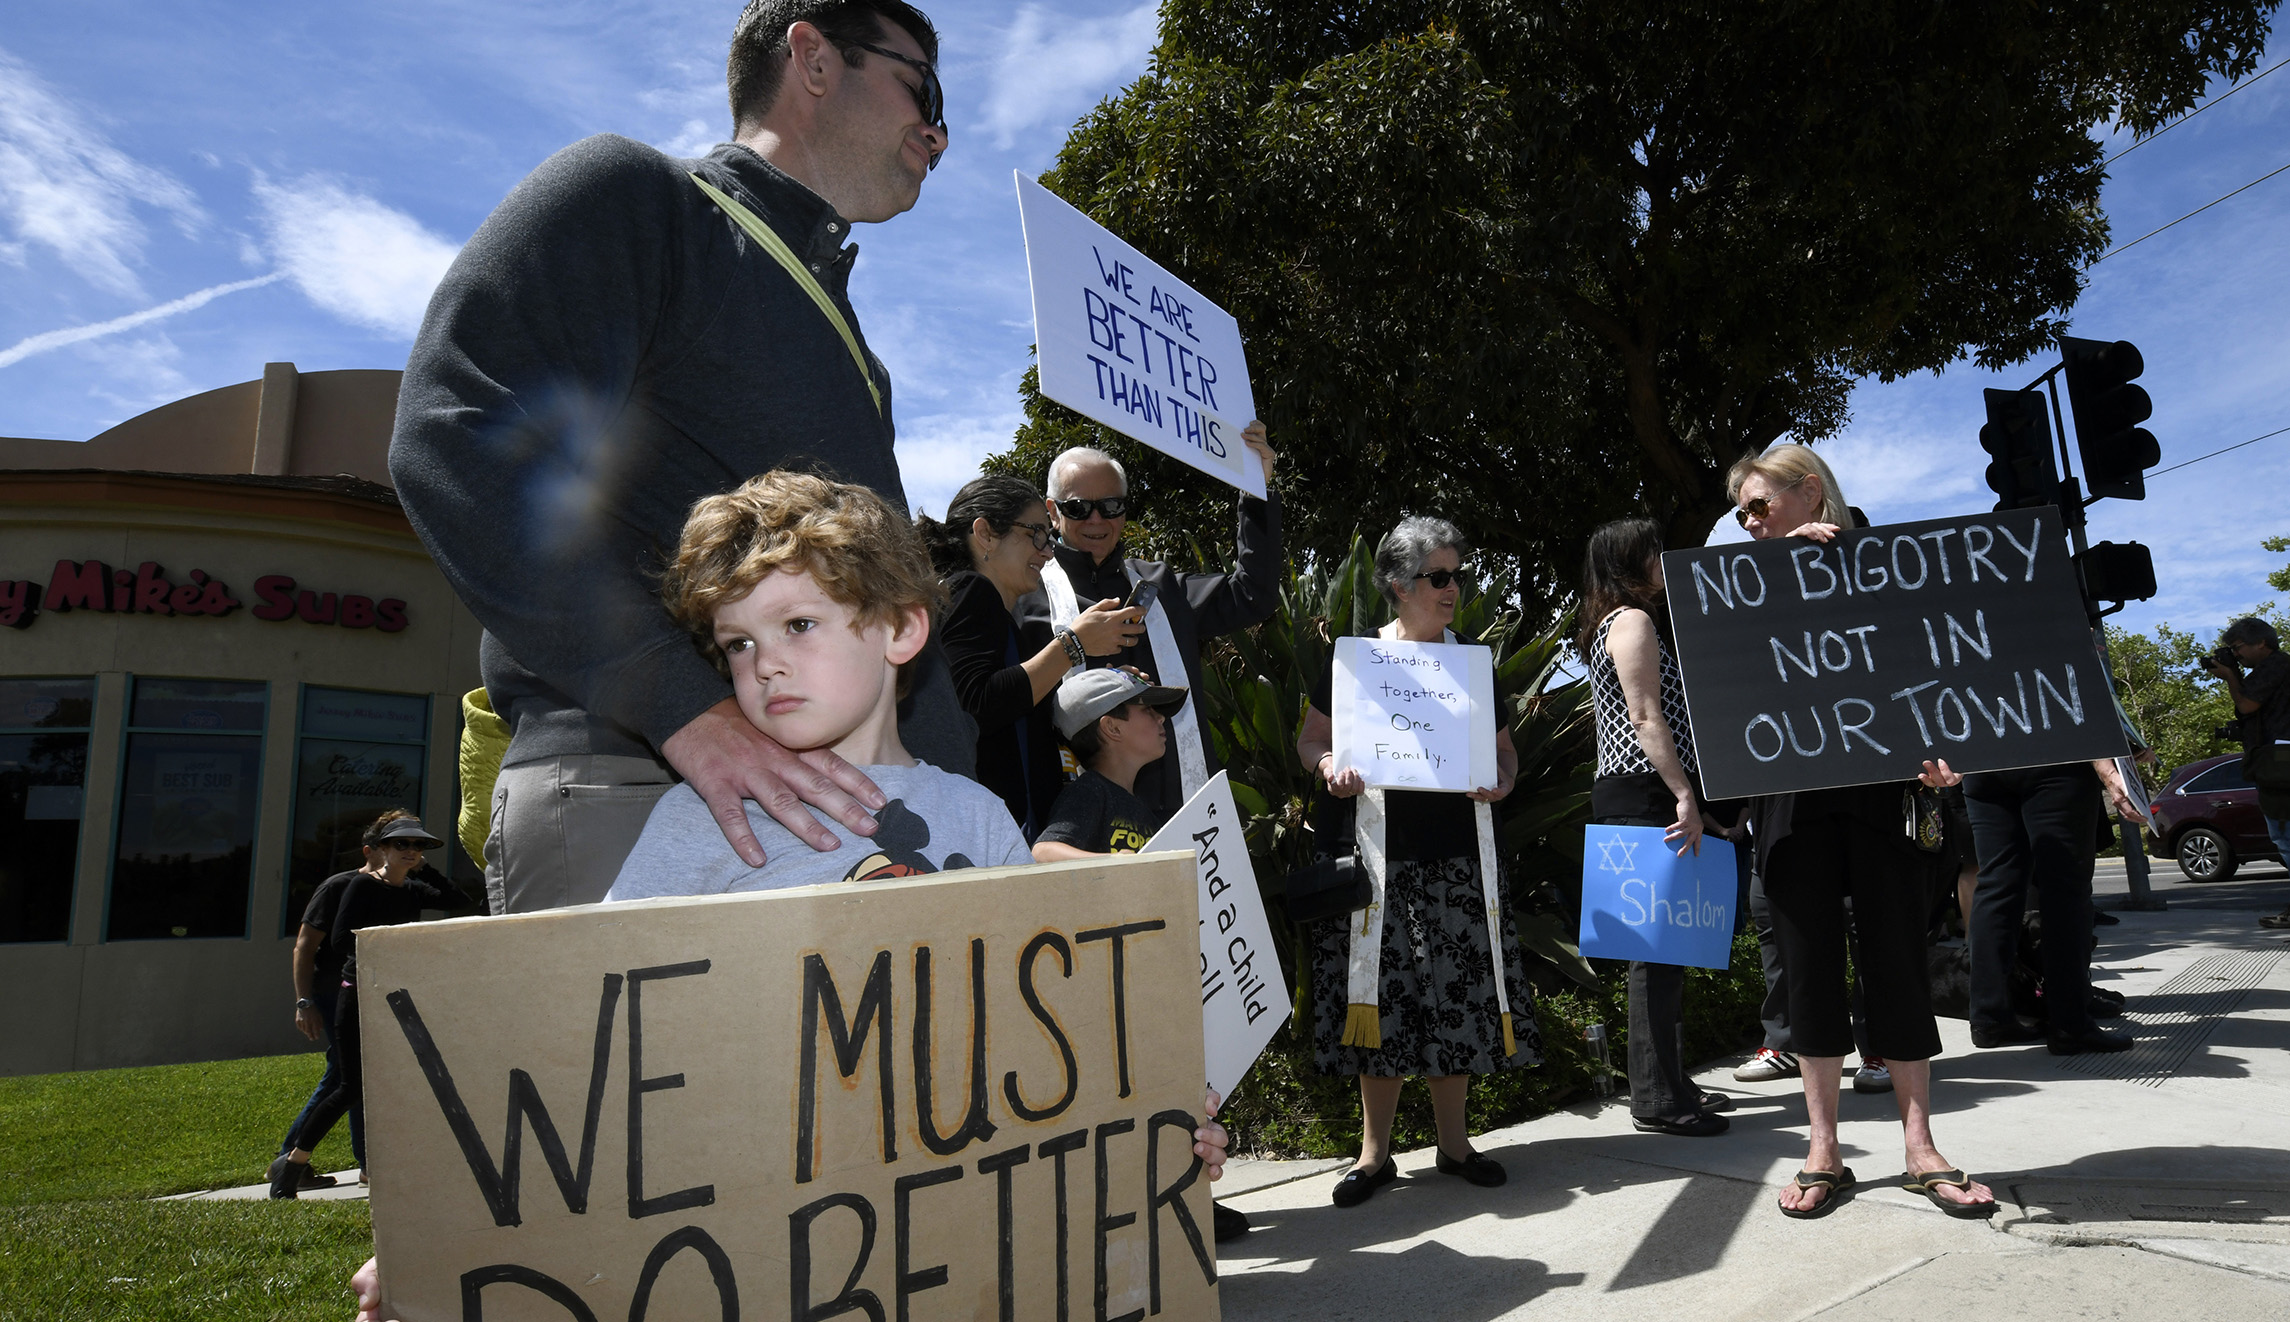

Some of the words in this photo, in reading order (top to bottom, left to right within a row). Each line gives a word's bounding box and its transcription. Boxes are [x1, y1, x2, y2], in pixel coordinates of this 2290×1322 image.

[1093, 246, 1141, 306] WE
[1150, 285, 1200, 343] ARE
[1084, 287, 1219, 411] BETTER
[1087, 353, 1163, 429] THAN
[1167, 396, 1227, 459] THIS
[43, 559, 241, 617] Mike's
[1691, 553, 1767, 615] NO
[1789, 517, 2042, 601] BIGOTRY
[1370, 648, 1441, 671] Standing
[1769, 624, 1878, 683] NOT
[1922, 608, 1992, 668] IN
[1379, 681, 1457, 703] together,
[1744, 697, 1891, 763] OUR
[1890, 663, 2085, 748] TOWN
[1391, 713, 1435, 732] One
[162, 772, 199, 787] BEST
[203, 772, 233, 787] SUB
[327, 754, 403, 784] Catering
[1375, 743, 1447, 769] Family.
[310, 777, 410, 798] Available!
[1110, 829, 1151, 850] FOR
[1620, 878, 1725, 931] Shalom
[1217, 903, 1237, 934] a
[1228, 936, 1268, 1026] child
[386, 959, 715, 1227] WE
[796, 919, 1166, 1184] MUST
[788, 1109, 1218, 1322] BETTER
